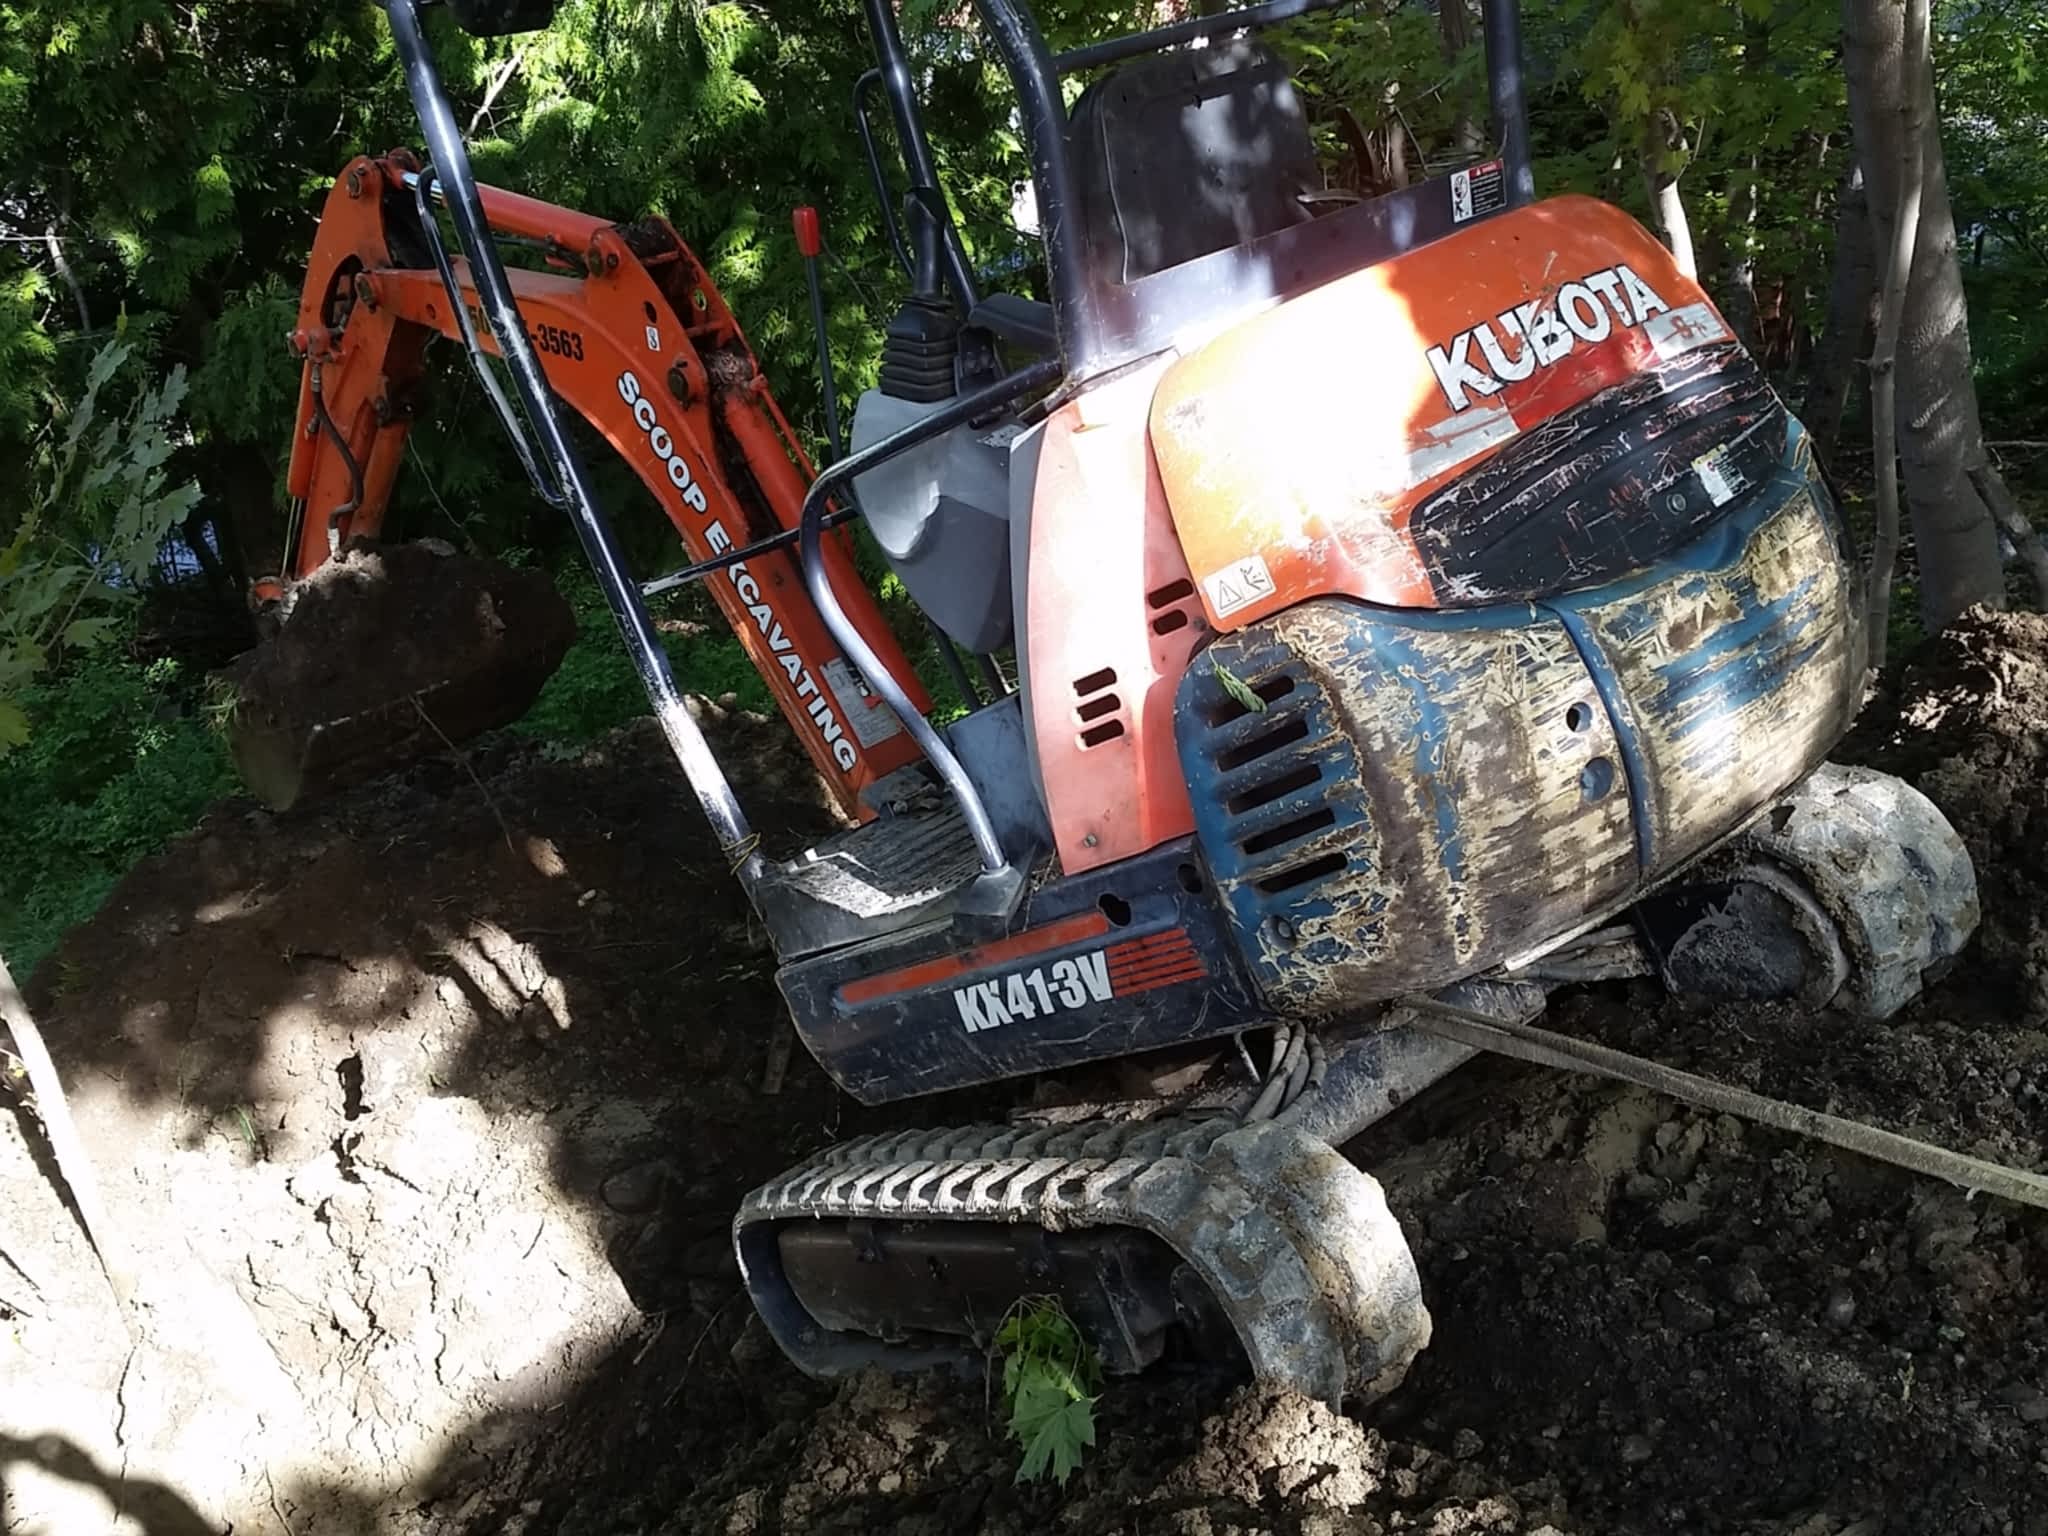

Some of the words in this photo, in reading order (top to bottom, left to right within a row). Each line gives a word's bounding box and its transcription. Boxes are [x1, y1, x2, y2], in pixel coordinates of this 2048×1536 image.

[1426, 264, 1671, 413] KUBOTA
[616, 370, 707, 513] SCOOP
[953, 950, 1113, 1033] KX41-3V
